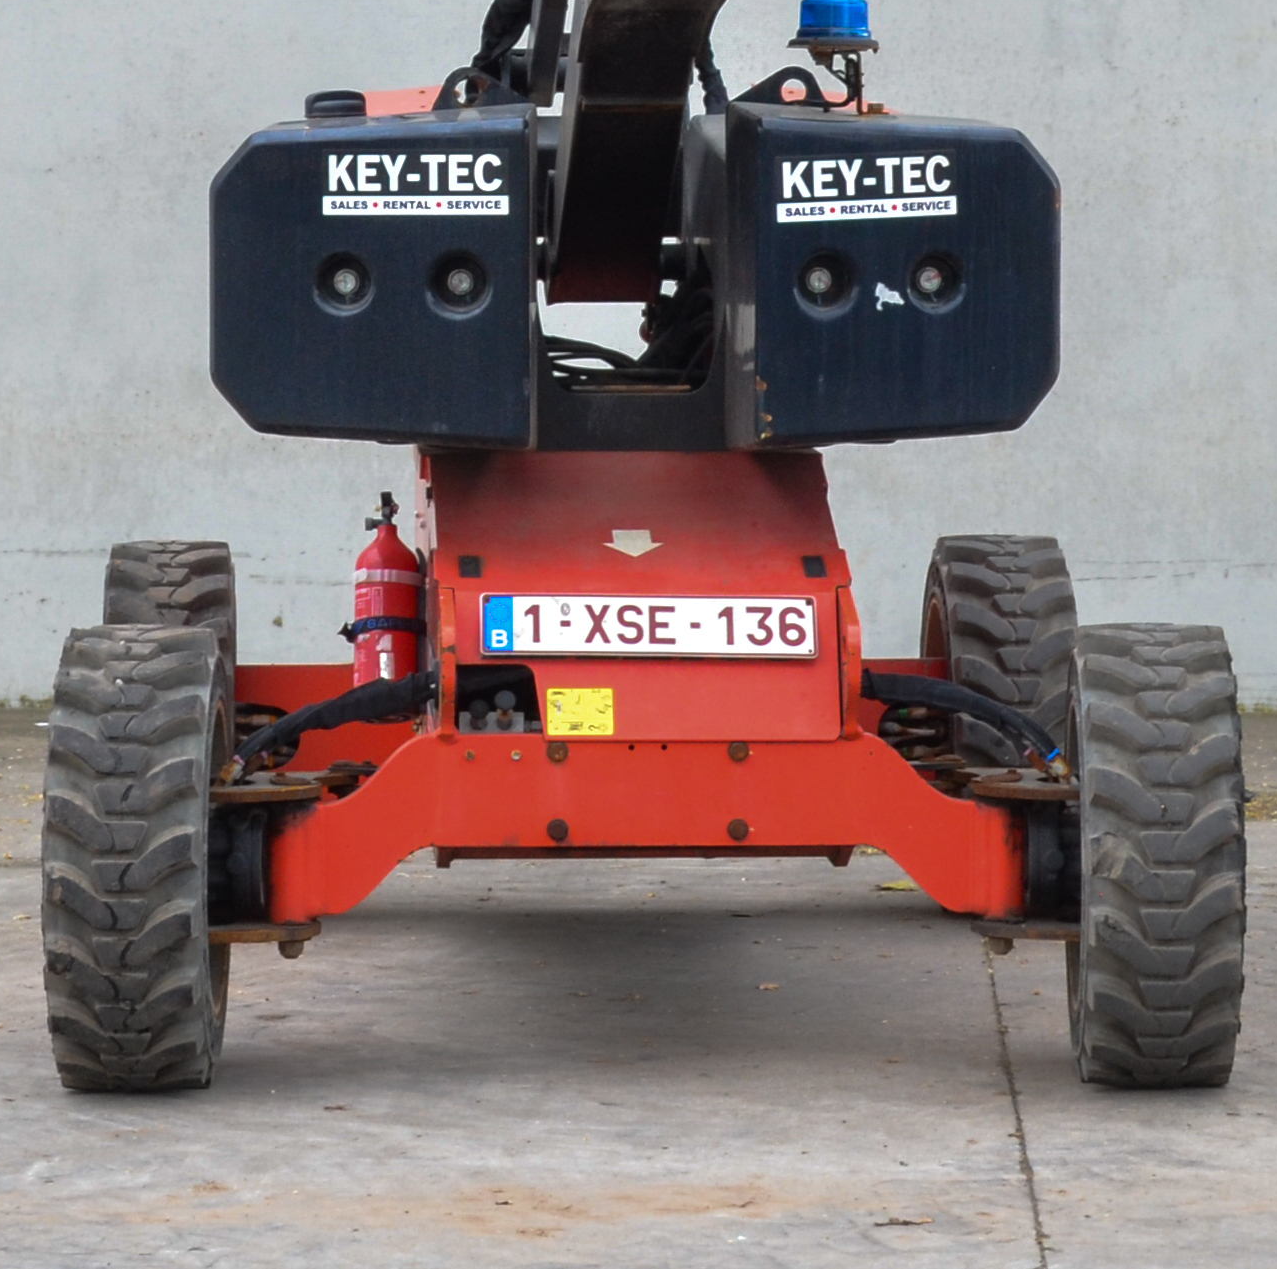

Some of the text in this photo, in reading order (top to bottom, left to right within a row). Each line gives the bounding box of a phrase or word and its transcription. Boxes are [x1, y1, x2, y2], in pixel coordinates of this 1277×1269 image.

[328, 153, 503, 192] KEY-TEC
[782, 154, 951, 199] KEY-TEC
[330, 200, 502, 210] SALES RENTAL SERVICE
[785, 200, 951, 217] SALES RENTAL SERVICE
[491, 629, 508, 647] B
